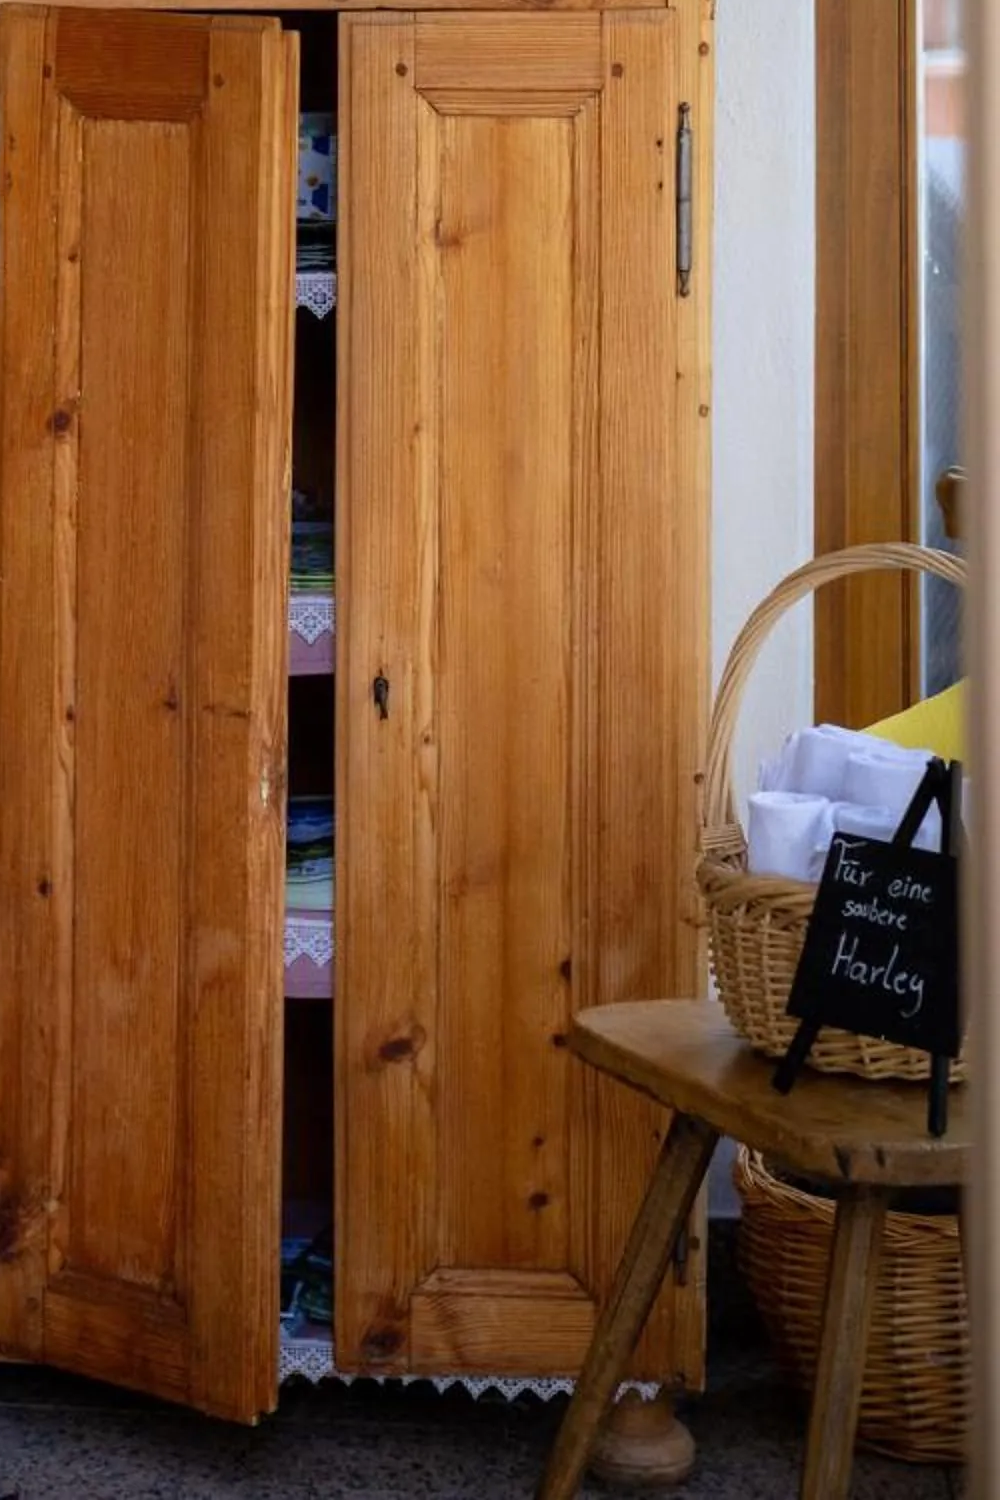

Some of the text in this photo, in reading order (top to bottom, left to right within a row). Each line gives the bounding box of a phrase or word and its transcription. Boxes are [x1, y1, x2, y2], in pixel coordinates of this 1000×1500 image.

[833, 837, 933, 902] Für eine
[831, 931, 925, 1018] Harley
